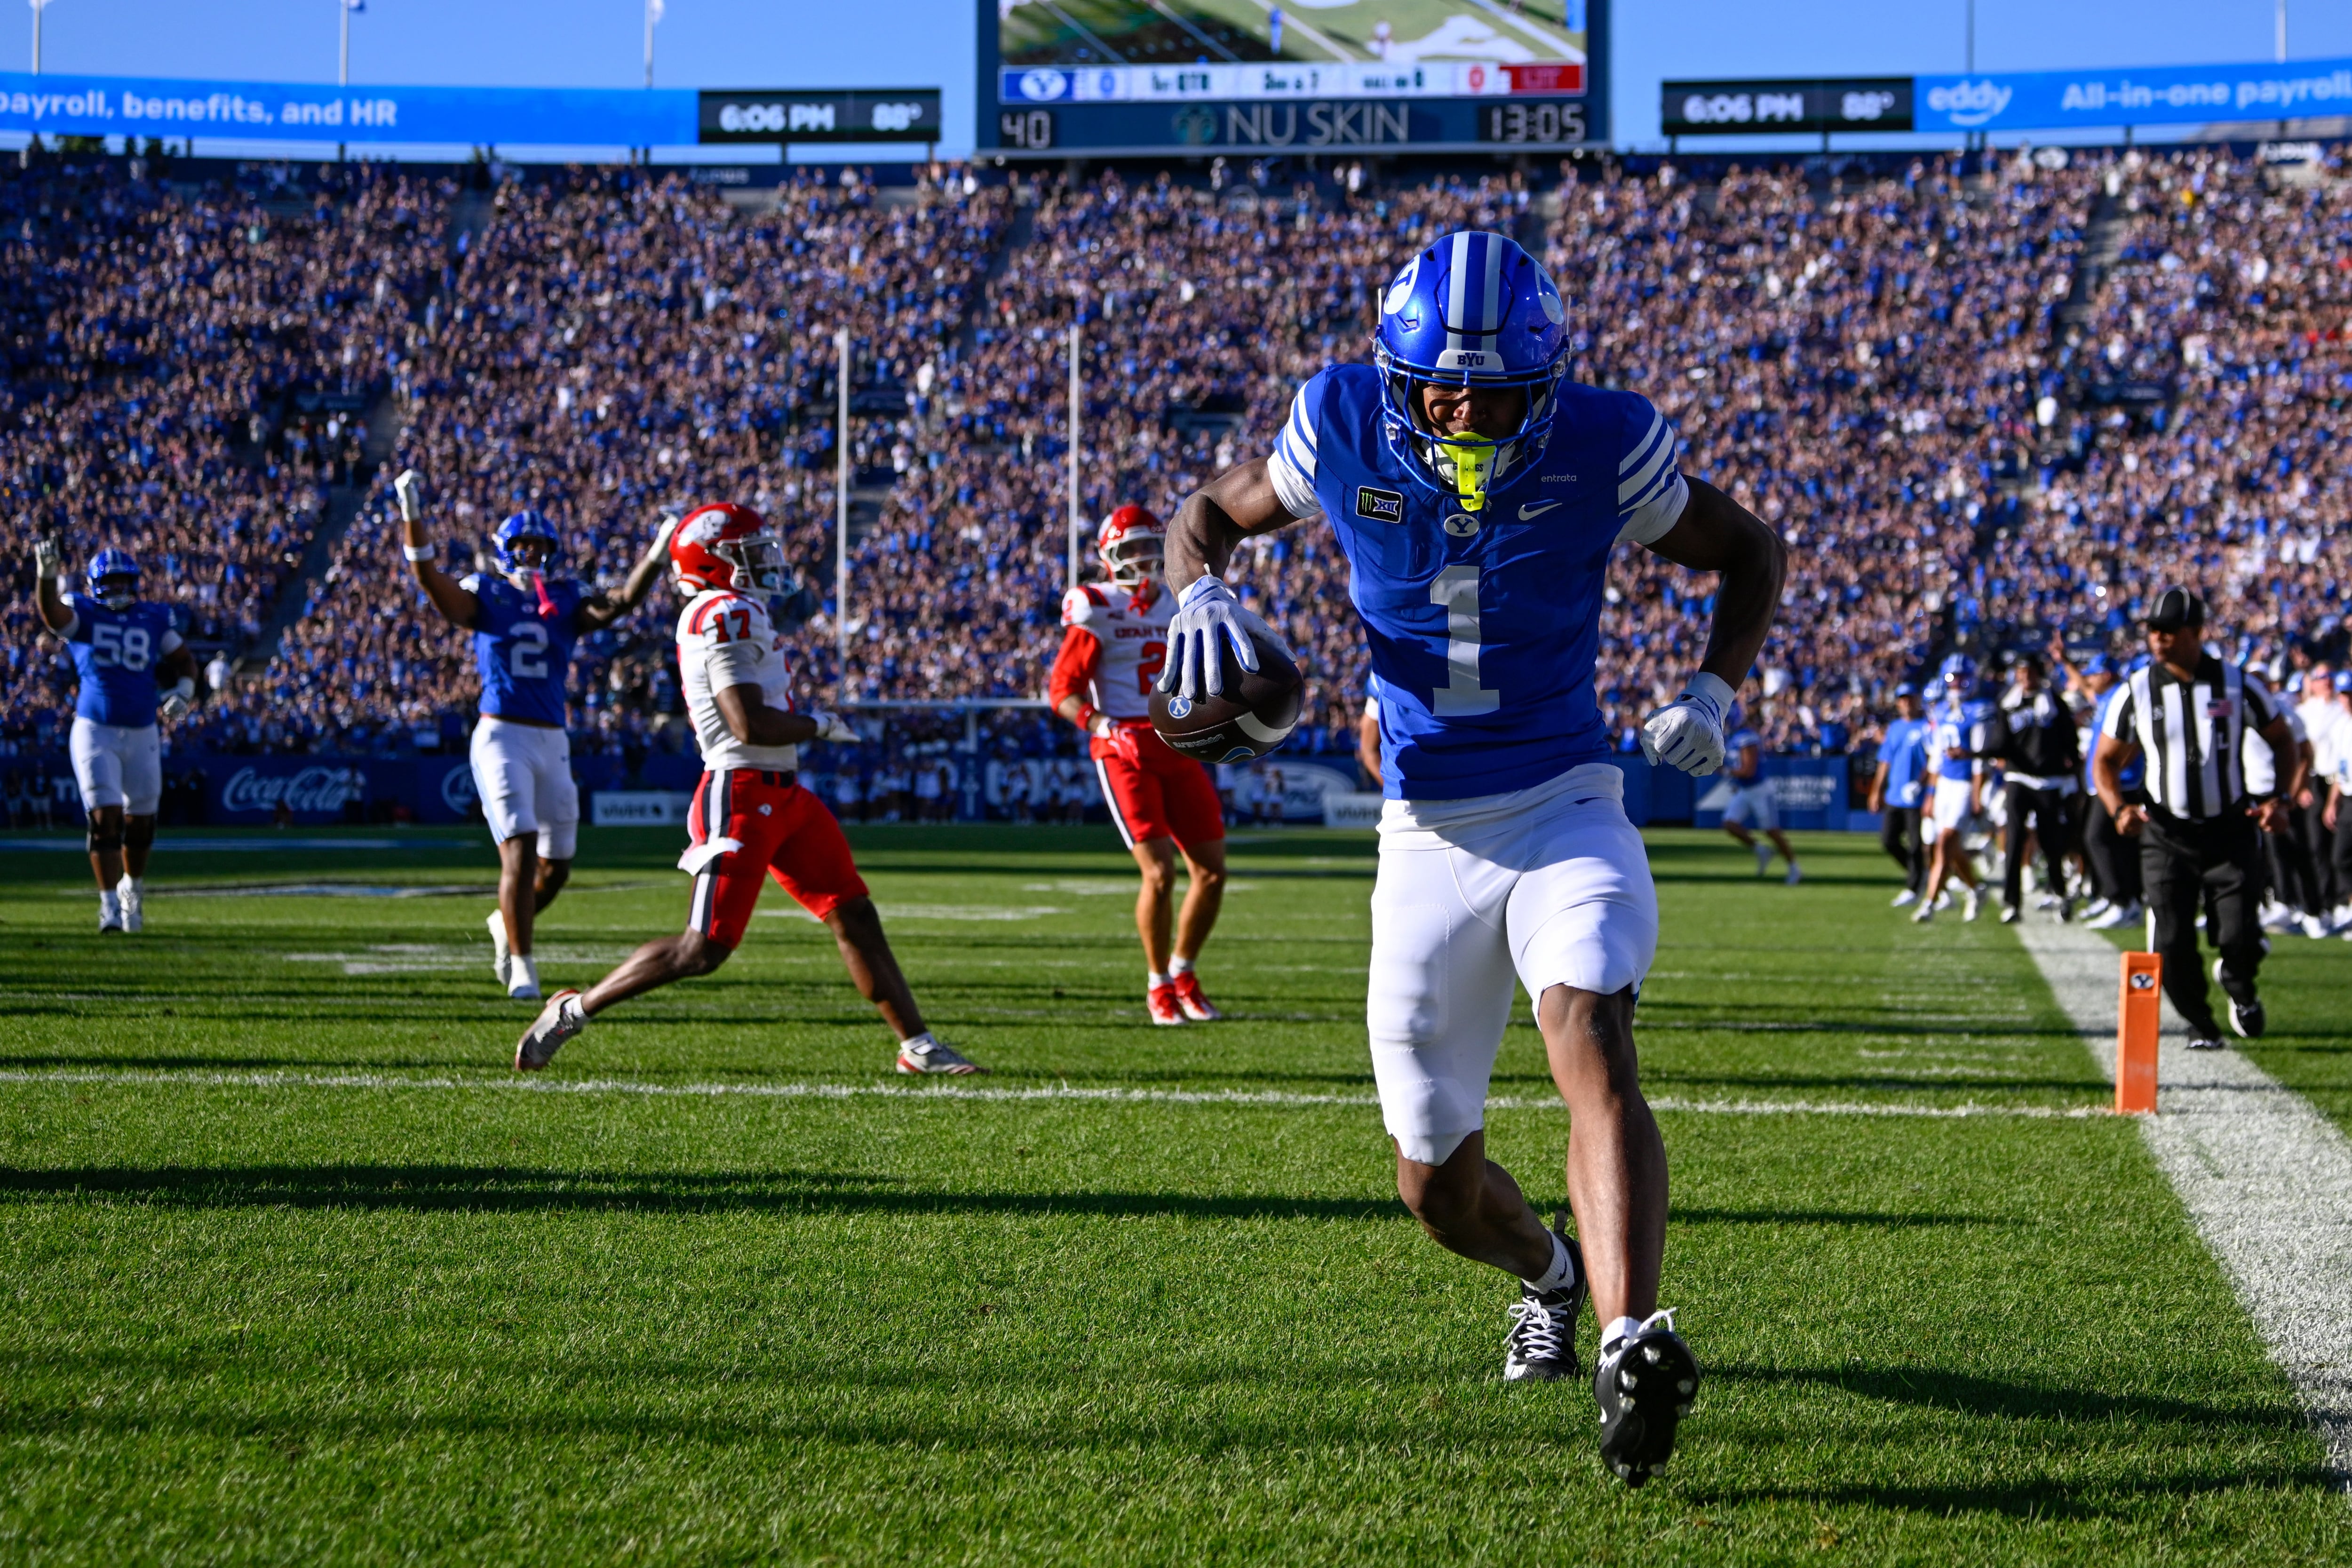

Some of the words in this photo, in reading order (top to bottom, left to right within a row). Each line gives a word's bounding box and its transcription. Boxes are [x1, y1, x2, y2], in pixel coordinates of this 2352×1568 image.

[122, 92, 274, 124] benefits,
[281, 99, 342, 125] and
[350, 100, 397, 127] HR
[1756, 93, 1804, 123] PM
[1927, 79, 2012, 118] eddy
[2062, 81, 2230, 110] All-in-one
[789, 103, 835, 132] PM
[1002, 111, 1051, 150] 40
[1226, 103, 1297, 147] NU
[1306, 101, 1409, 145] SKIN
[1491, 103, 1586, 143] 13:05
[1457, 352, 1485, 367] BYU
[1541, 473, 1577, 482] entrata
[1449, 517, 1473, 533] Y
[713, 609, 751, 644] 17
[1430, 565, 1500, 716] 1
[92, 622, 150, 672] 58
[509, 621, 549, 679] 2
[1138, 642, 1167, 696] 2
[2135, 975, 2151, 987] Y
